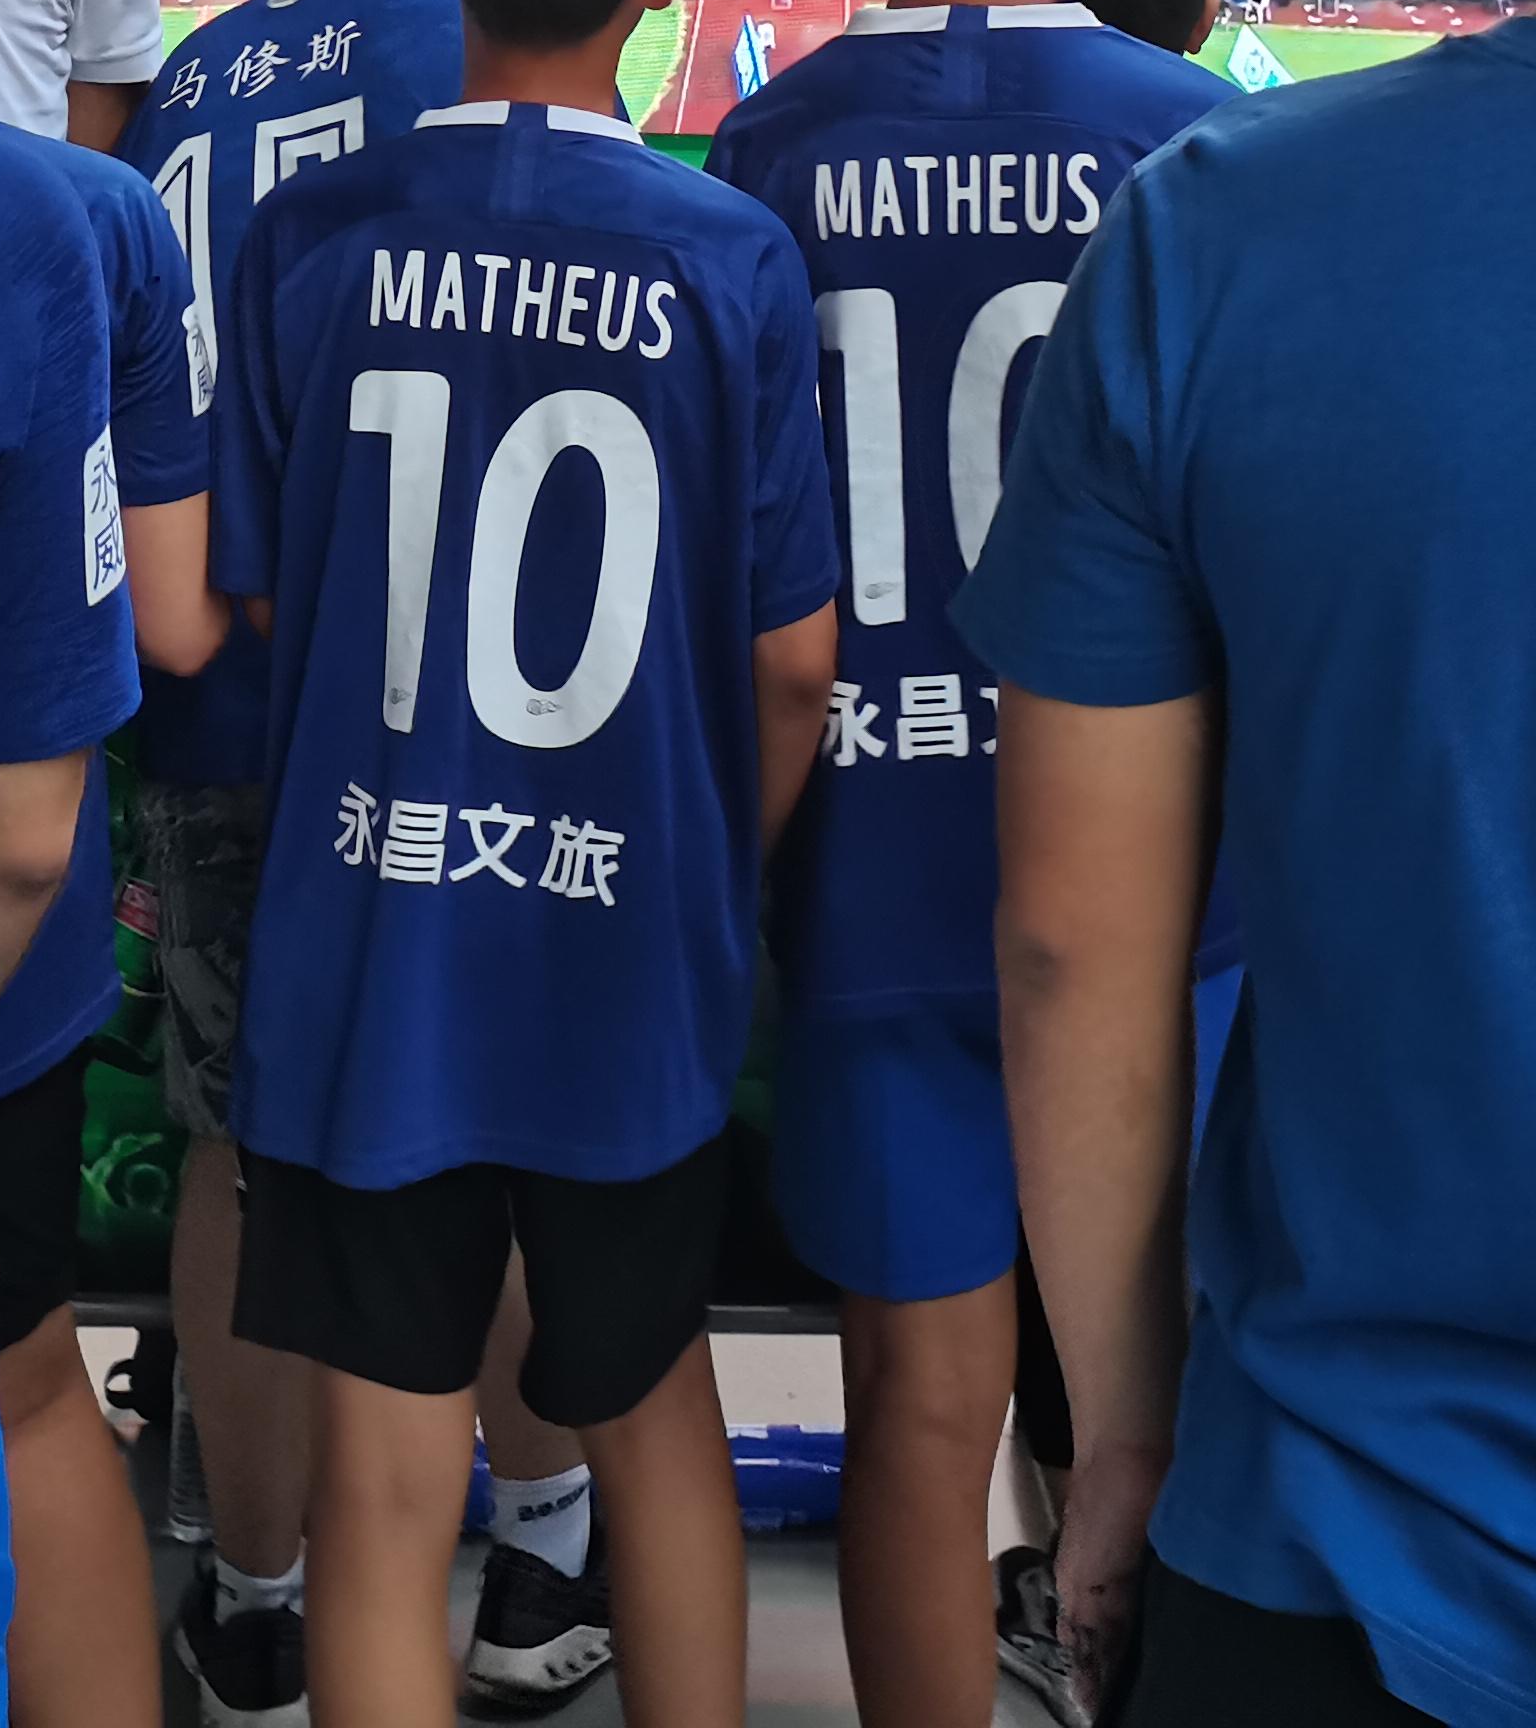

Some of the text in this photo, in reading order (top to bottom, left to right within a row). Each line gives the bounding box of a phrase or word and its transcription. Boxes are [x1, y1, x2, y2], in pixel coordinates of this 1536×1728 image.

[160, 20, 362, 110] 马修斯
[815, 153, 1101, 240] MATHEUS
[367, 248, 678, 359] MATHEUS
[349, 369, 661, 750] 10
[823, 673, 999, 767] 永昌
[333, 780, 625, 907] 永昌文旅
